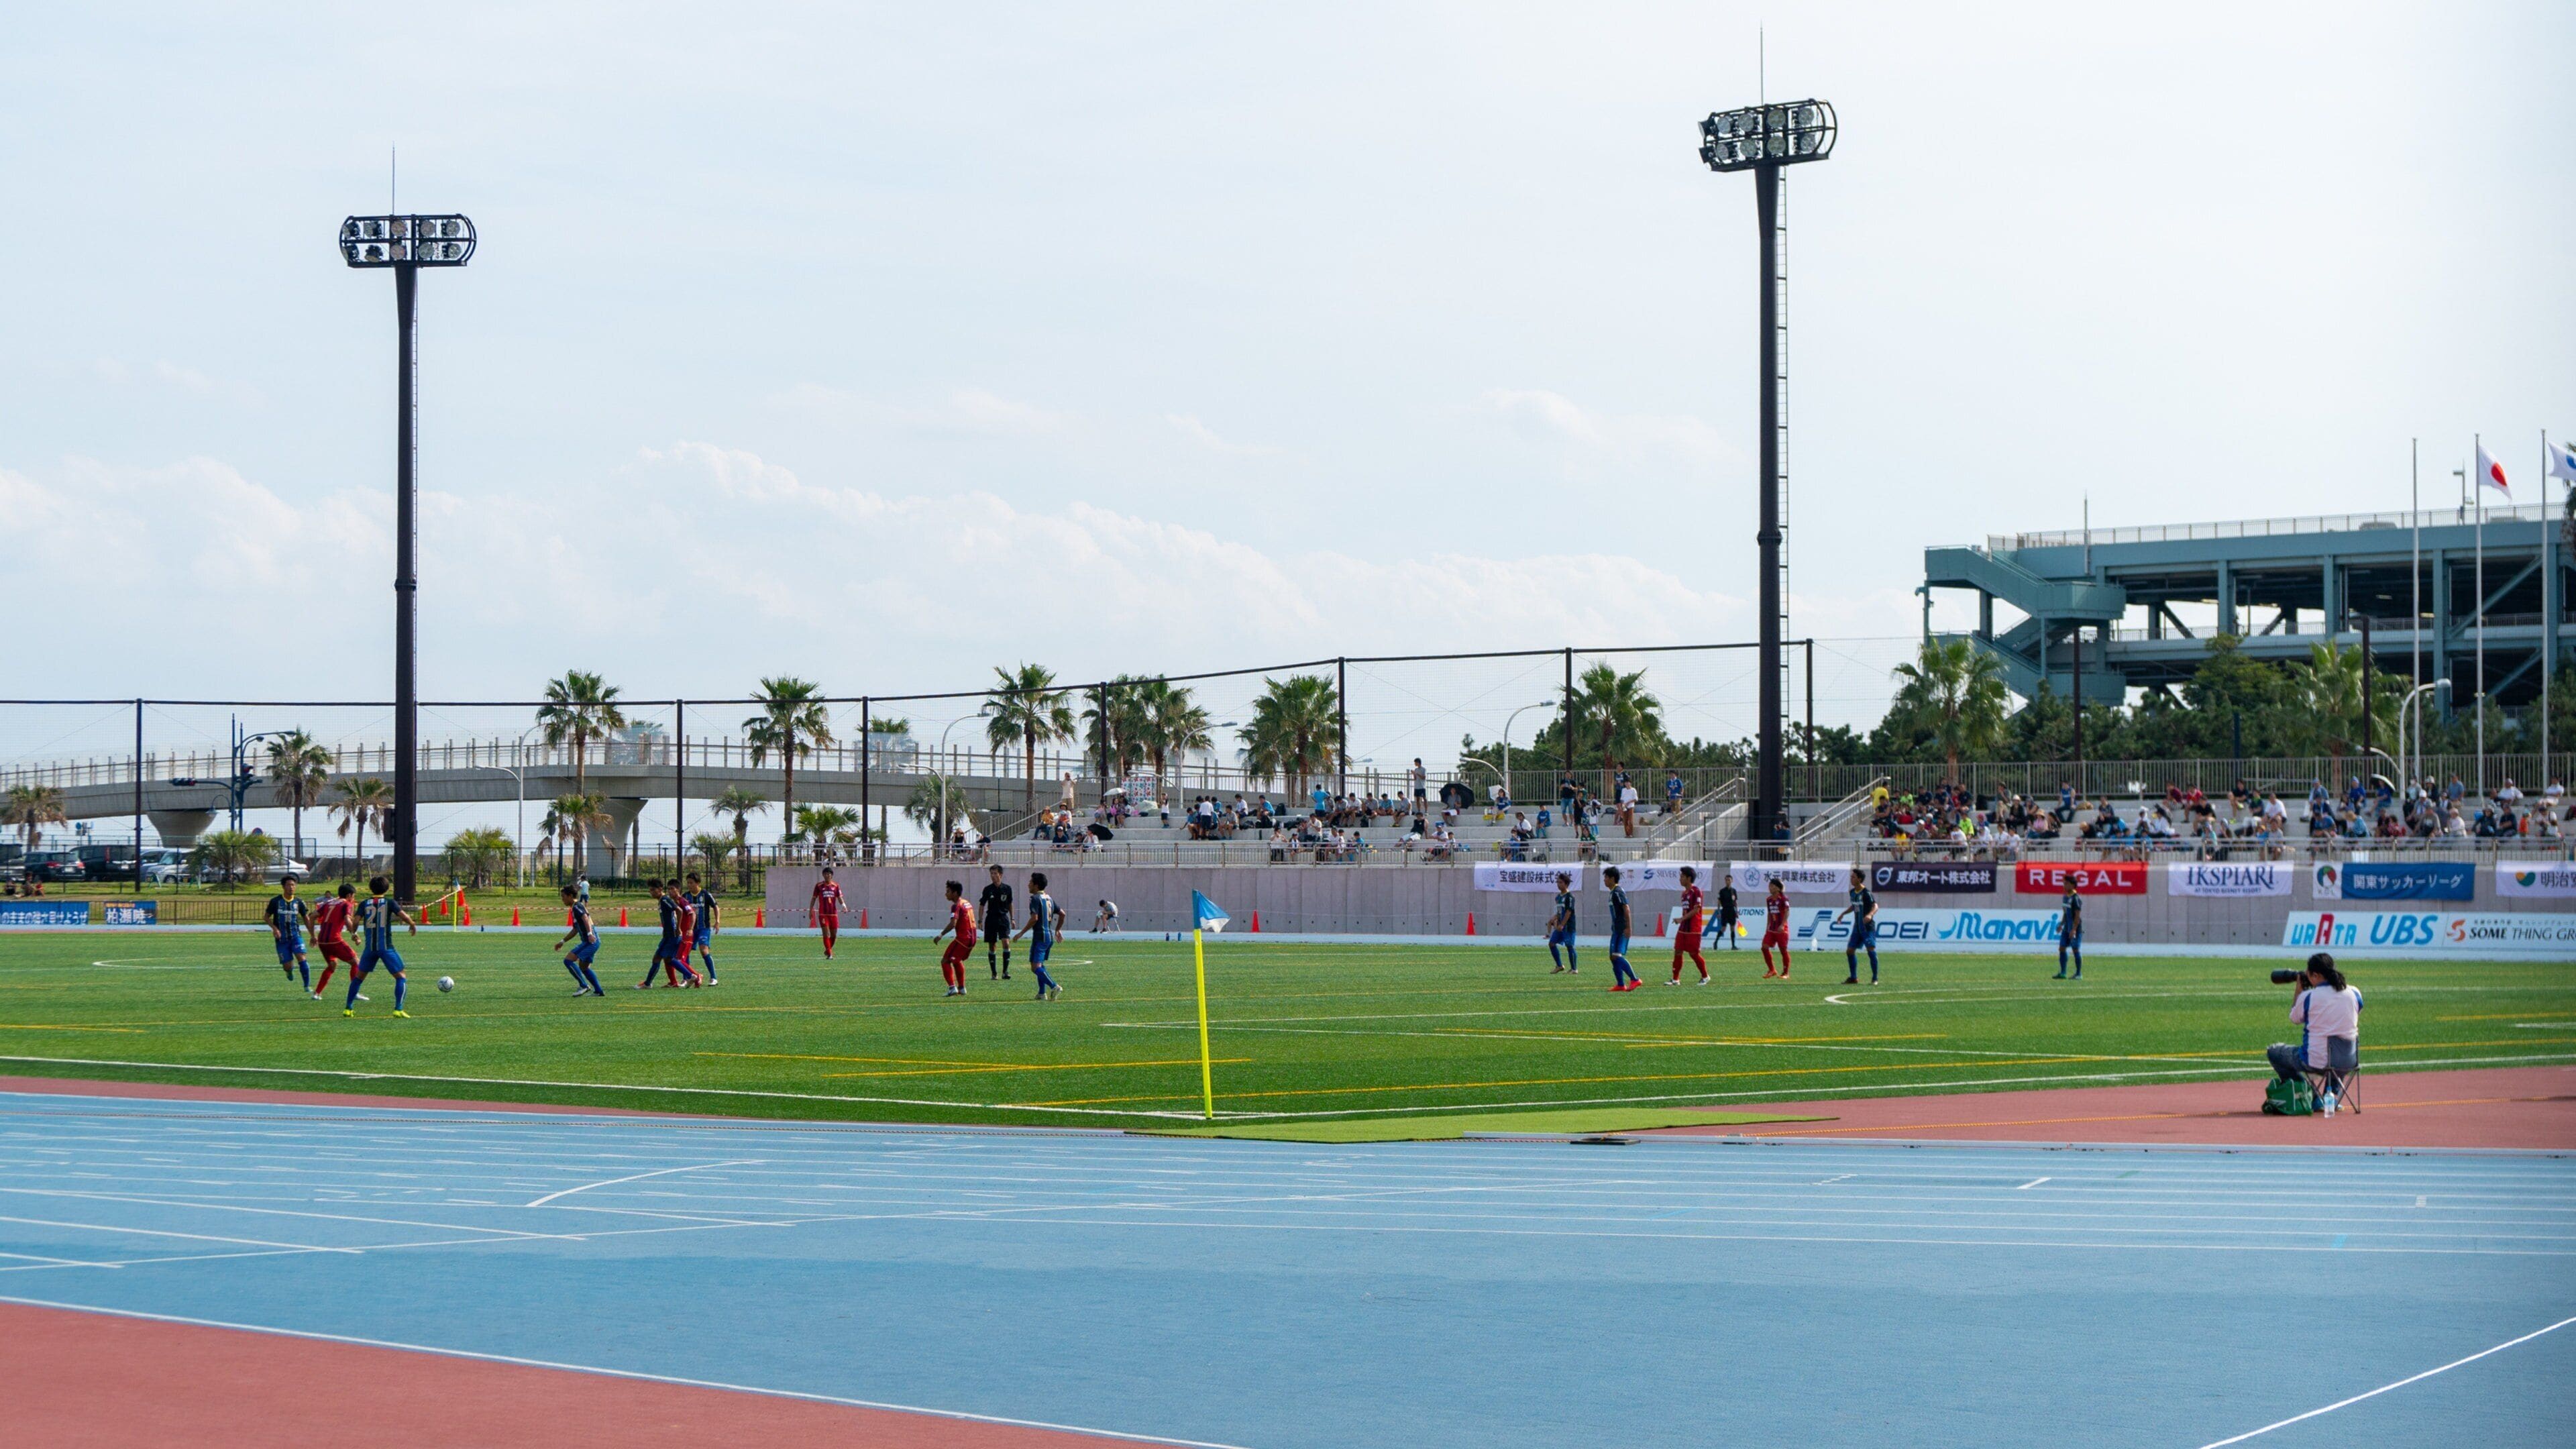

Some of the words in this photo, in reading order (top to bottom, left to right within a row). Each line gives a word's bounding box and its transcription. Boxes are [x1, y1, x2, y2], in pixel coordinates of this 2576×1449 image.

[1896, 871, 1992, 884] 東邦オート株式会社
[2029, 869, 2133, 887] REGAL
[2188, 866, 2275, 890] IKSPIARI
[2353, 873, 2465, 890] 関東サッカーリーグ
[365, 905, 387, 928] 21
[1827, 922, 1929, 939] SOEI
[2370, 914, 2438, 946] UBS
[2469, 927, 2508, 939] SOME
[2512, 927, 2552, 941] THING
[2557, 928, 2576, 941] GR
